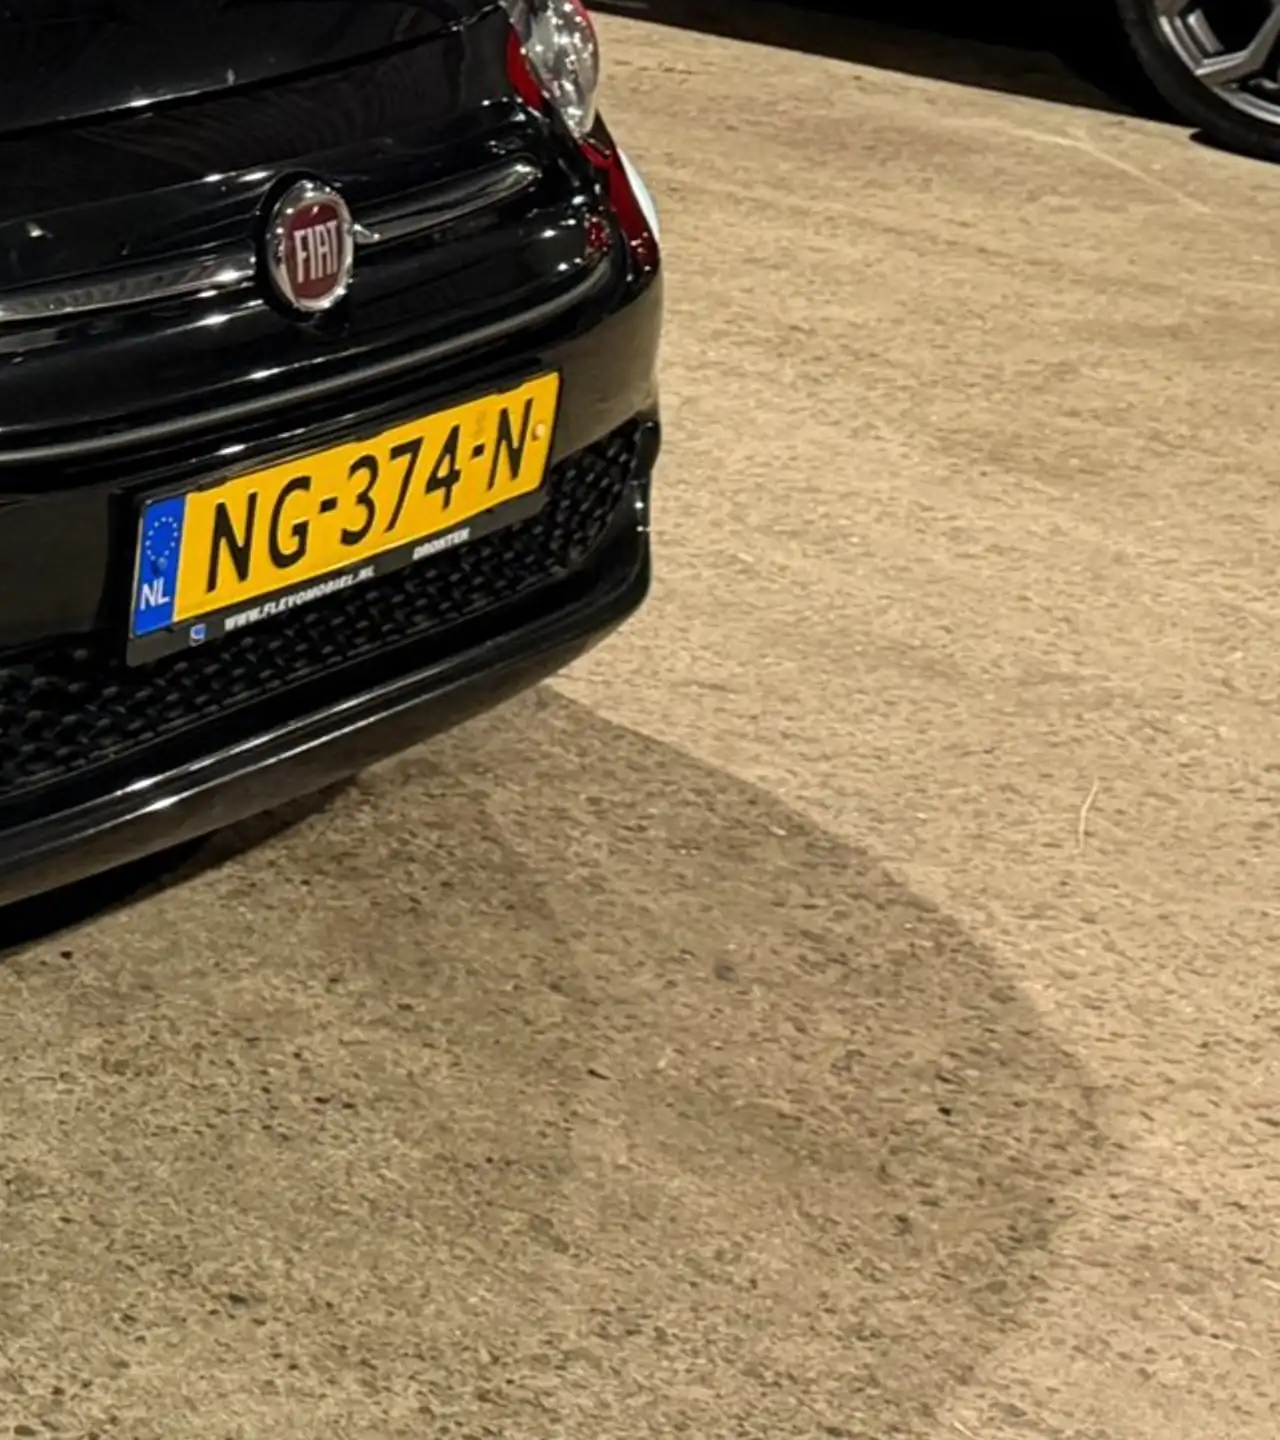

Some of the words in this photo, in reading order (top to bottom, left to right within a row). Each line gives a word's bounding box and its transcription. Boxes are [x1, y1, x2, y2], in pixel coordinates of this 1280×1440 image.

[292, 219, 339, 285] FIAT
[205, 396, 535, 594] NG-374-N
[139, 576, 171, 612] NL
